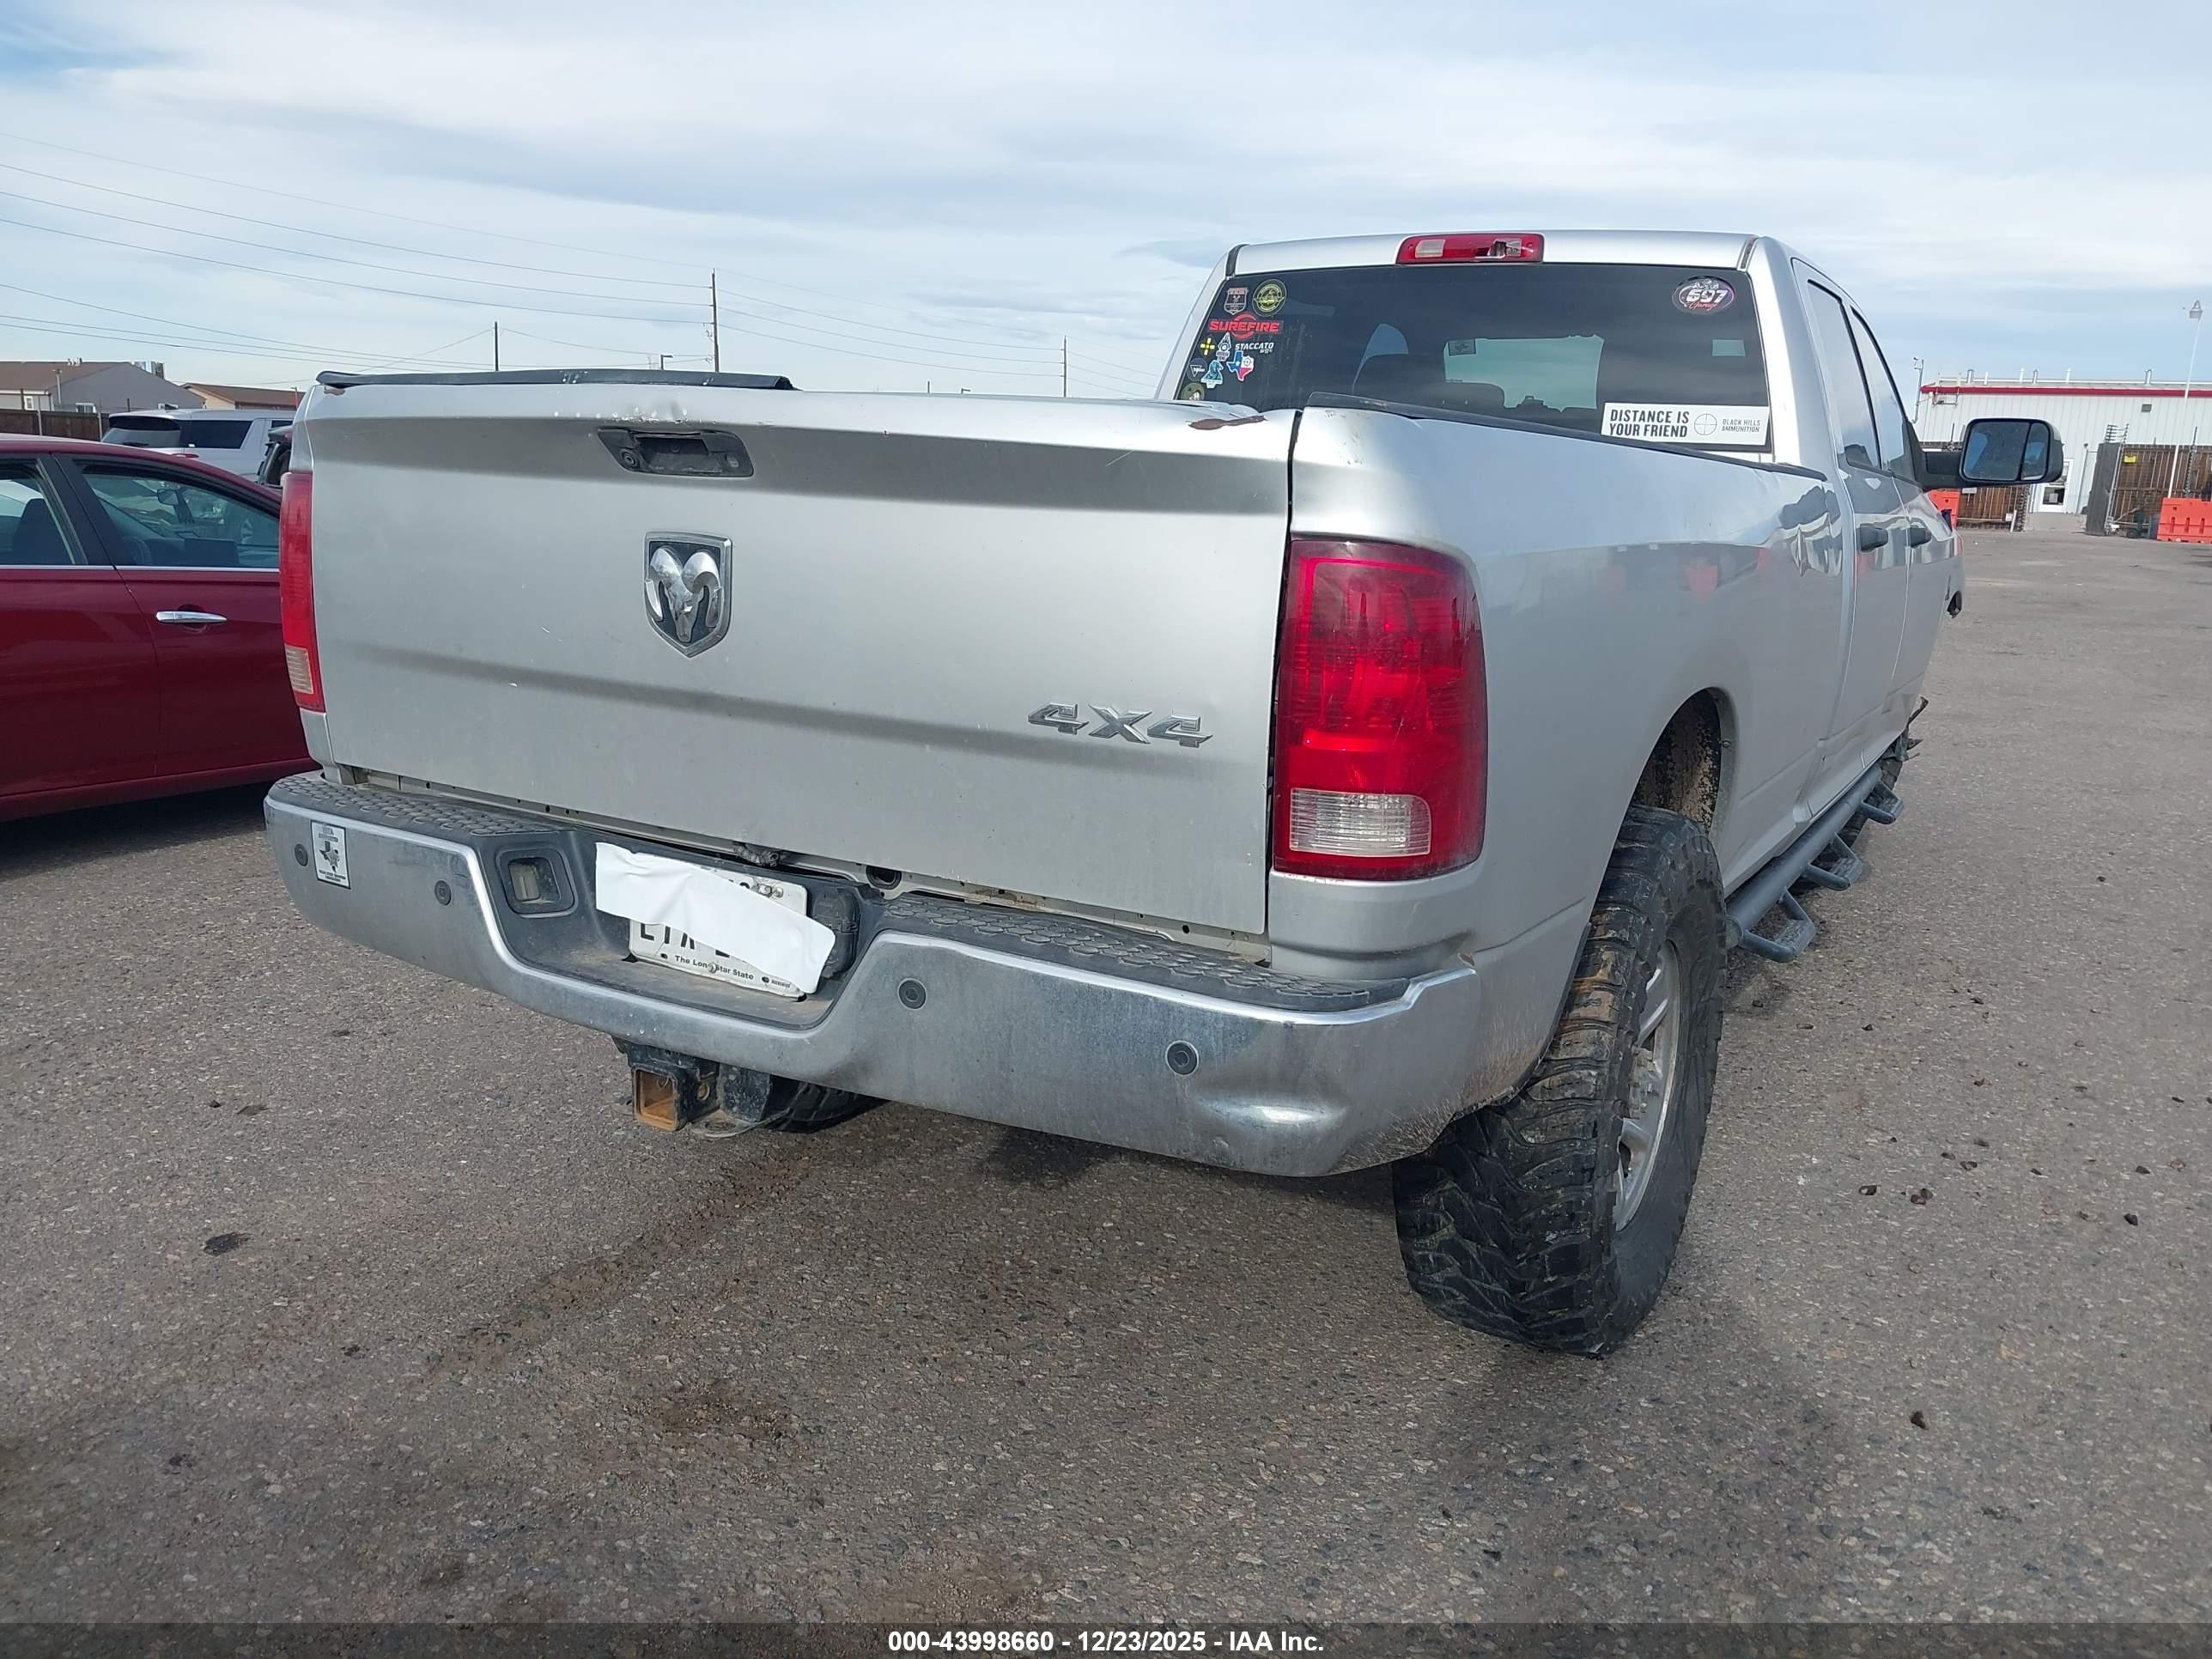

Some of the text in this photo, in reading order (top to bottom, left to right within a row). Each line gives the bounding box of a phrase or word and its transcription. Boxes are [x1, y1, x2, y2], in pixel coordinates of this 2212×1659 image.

[1209, 320, 1280, 332] SUREFIRE
[1235, 342, 1274, 350] STACCATO
[1610, 410, 1690, 424] DISTANCE IS
[1609, 423, 1688, 438] YOUR FRIEND
[674, 955, 755, 981] The Lon Star State
